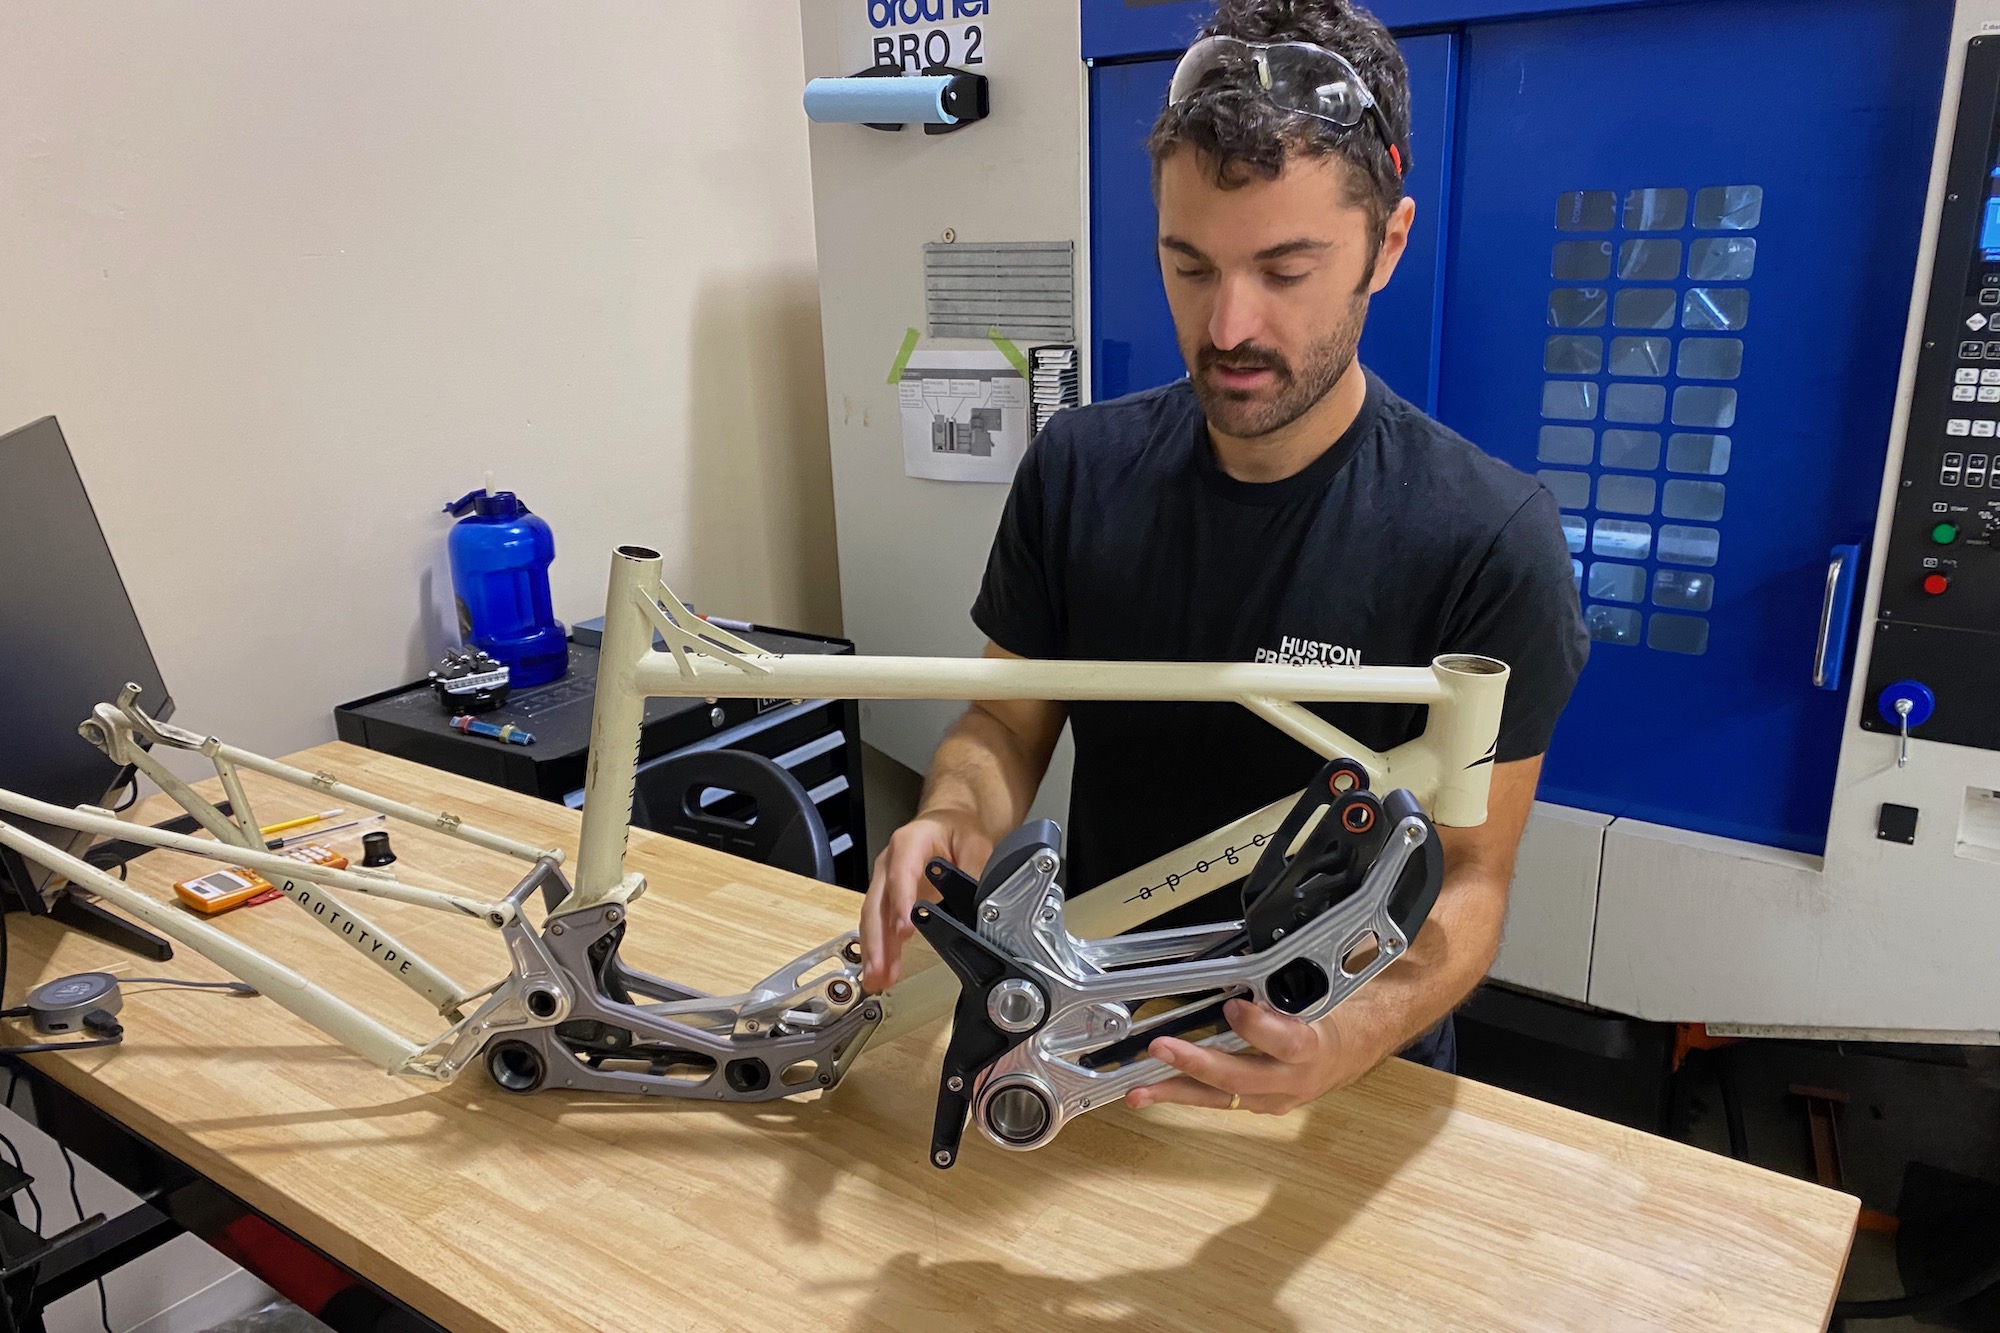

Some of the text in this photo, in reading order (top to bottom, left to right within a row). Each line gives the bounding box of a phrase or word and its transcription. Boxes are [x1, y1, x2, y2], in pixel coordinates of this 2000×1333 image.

[873, 26, 983, 72] BRO 2
[1280, 635, 1361, 666] HUSTON
[282, 880, 412, 975] PROTOTYPE
